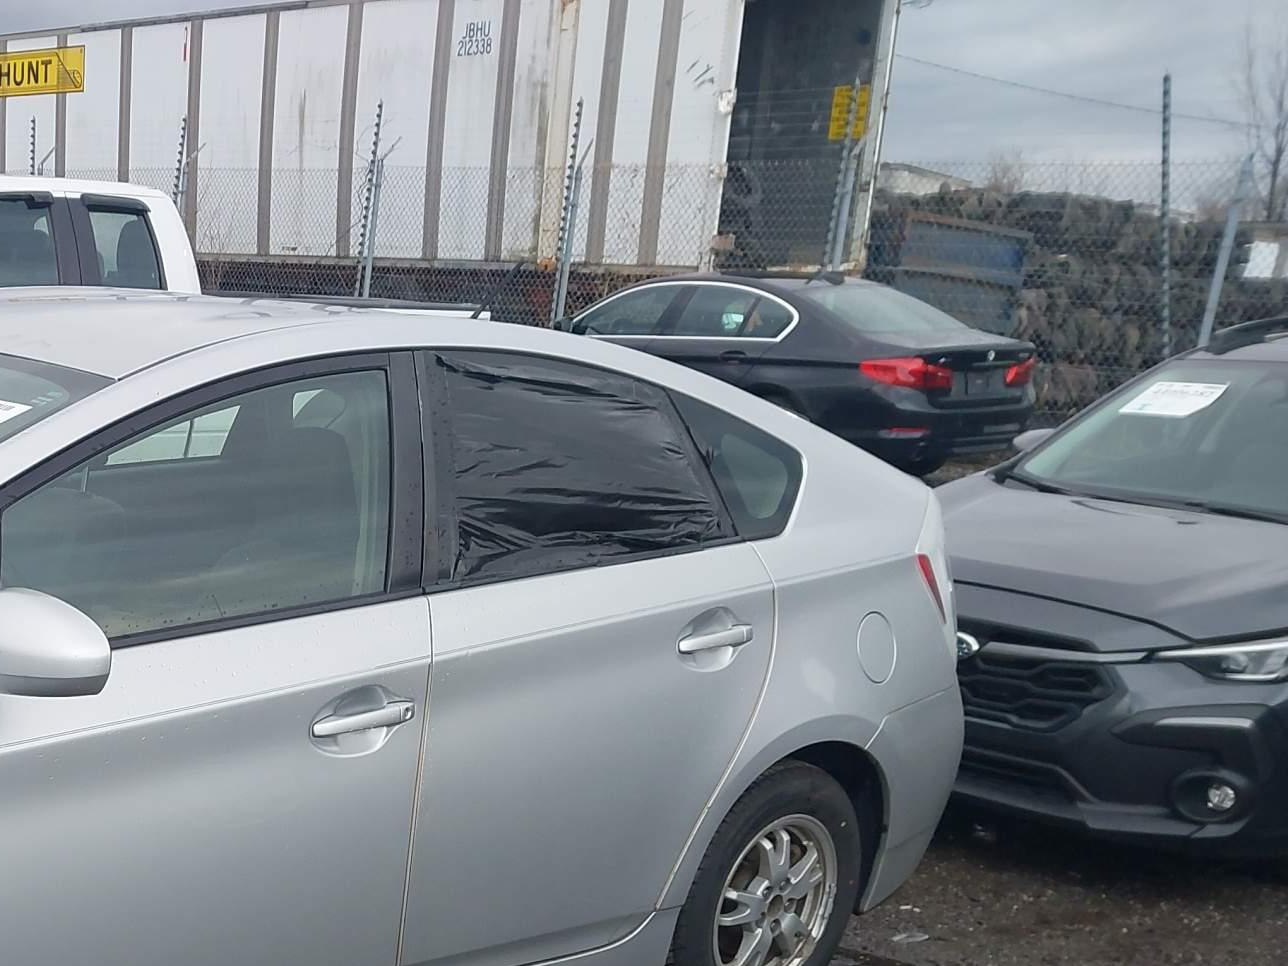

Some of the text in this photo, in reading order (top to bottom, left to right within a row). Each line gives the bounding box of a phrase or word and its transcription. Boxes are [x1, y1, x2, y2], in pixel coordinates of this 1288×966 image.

[462, 20, 491, 39] JBHU
[457, 38, 492, 56] 212338
[0, 59, 52, 87] HUNT
